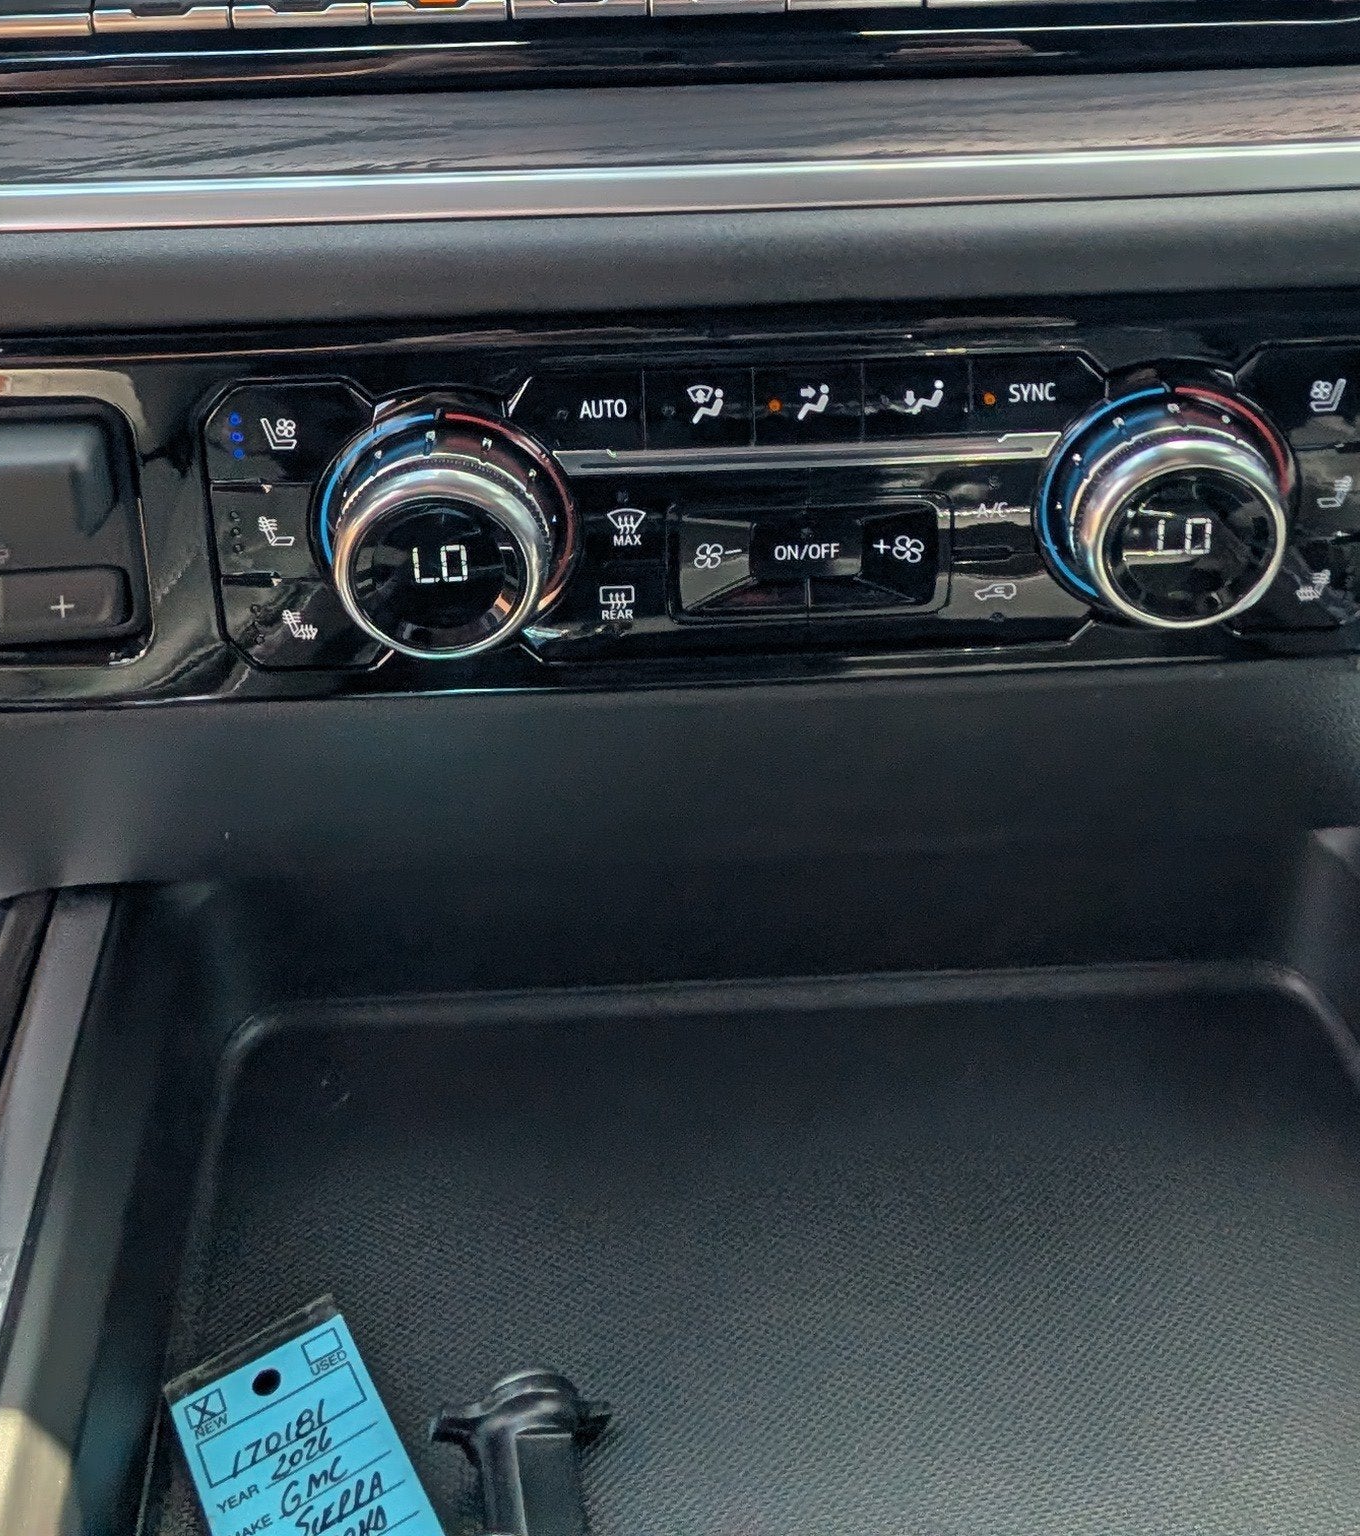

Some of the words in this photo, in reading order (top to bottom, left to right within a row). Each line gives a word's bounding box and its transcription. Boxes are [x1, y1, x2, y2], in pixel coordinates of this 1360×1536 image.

[1008, 382, 1056, 403] SYNC
[579, 398, 628, 419] AUTO
[977, 502, 1008, 519] A/C
[613, 533, 642, 547] MAX
[774, 542, 840, 562] ON/OFF
[413, 544, 468, 583] LO
[602, 608, 634, 621] REAR
[309, 1349, 348, 1376] USED
[194, 1412, 228, 1439] NEW
[231, 1398, 326, 1478] 170181
[271, 1426, 332, 1481] 2026
[216, 1484, 259, 1514] YEAR
[281, 1456, 349, 1517] GMC
